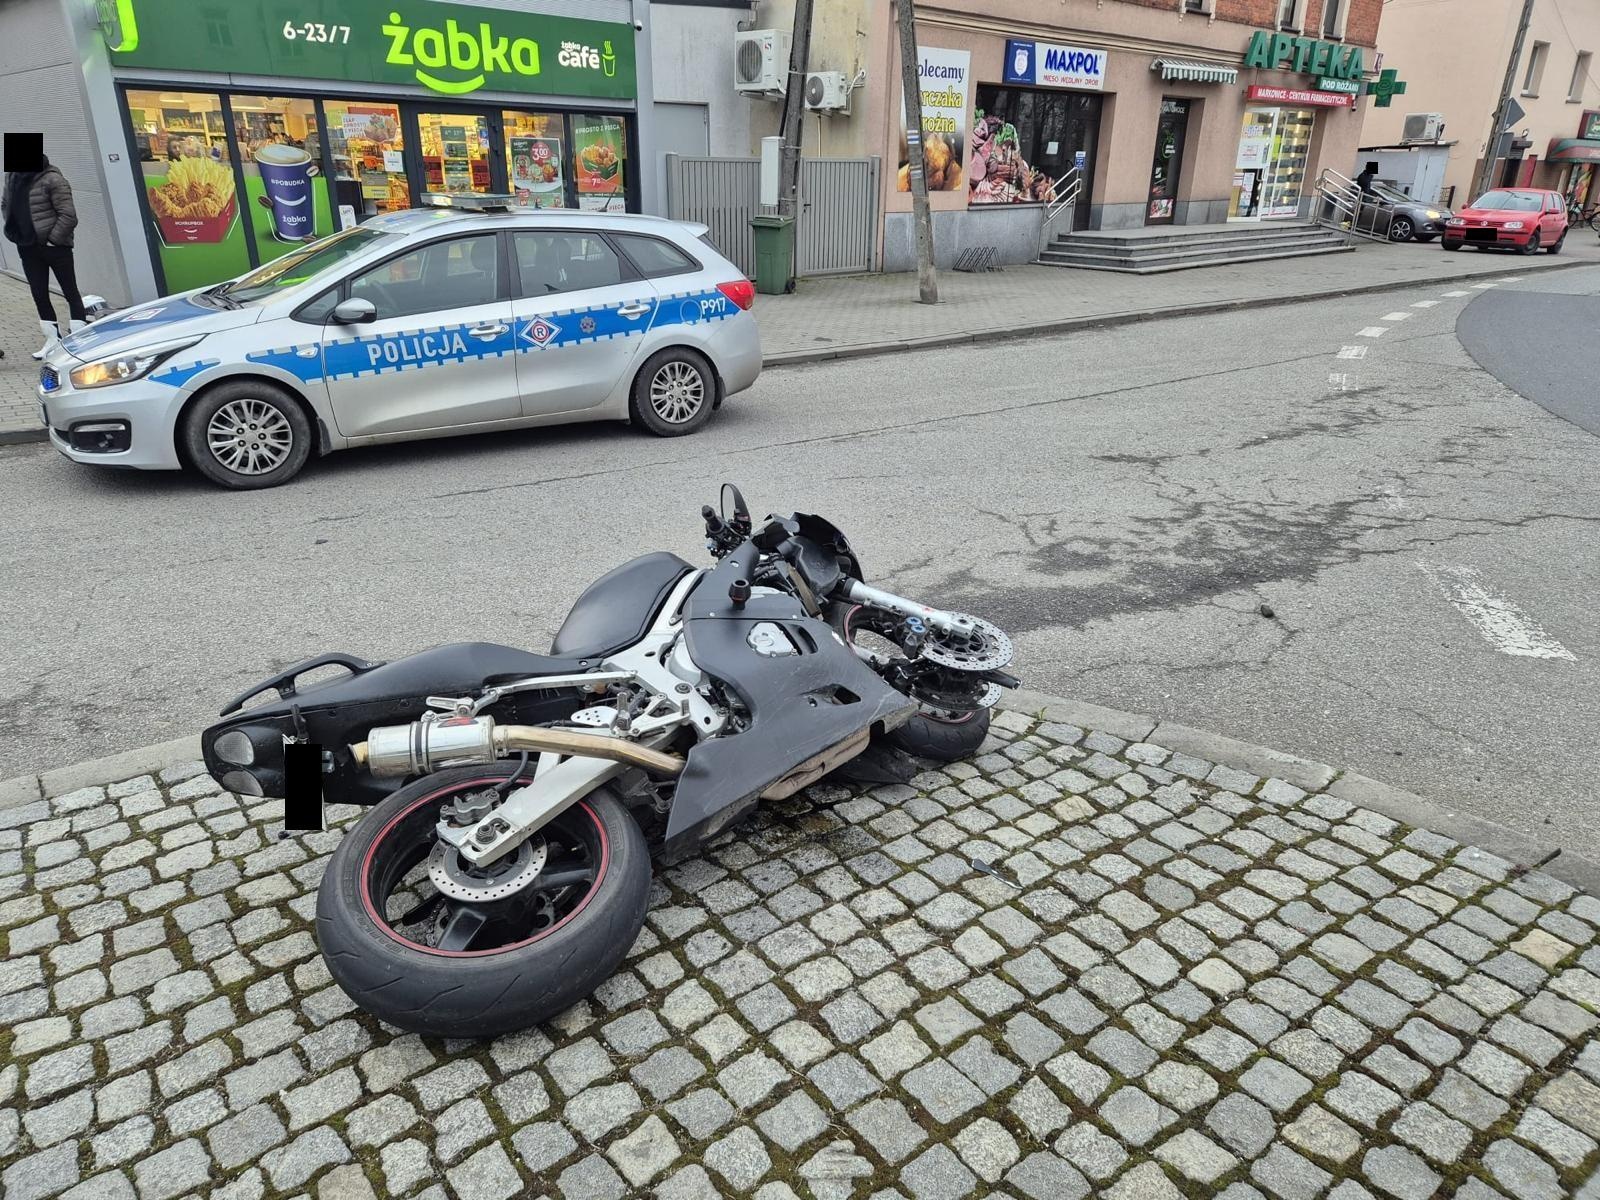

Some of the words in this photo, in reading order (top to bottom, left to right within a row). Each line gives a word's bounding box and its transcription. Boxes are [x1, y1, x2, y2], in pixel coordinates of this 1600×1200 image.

[283, 21, 350, 44] 6-23/7
[382, 12, 540, 75] żabka
[1045, 48, 1099, 75] MAXPOL
[1245, 31, 1364, 80] APTEKA
[918, 59, 964, 83] olecamy
[920, 86, 963, 108] rczaka
[701, 297, 727, 315] P917
[536, 327, 545, 337] R
[367, 332, 468, 366] POLICJA
